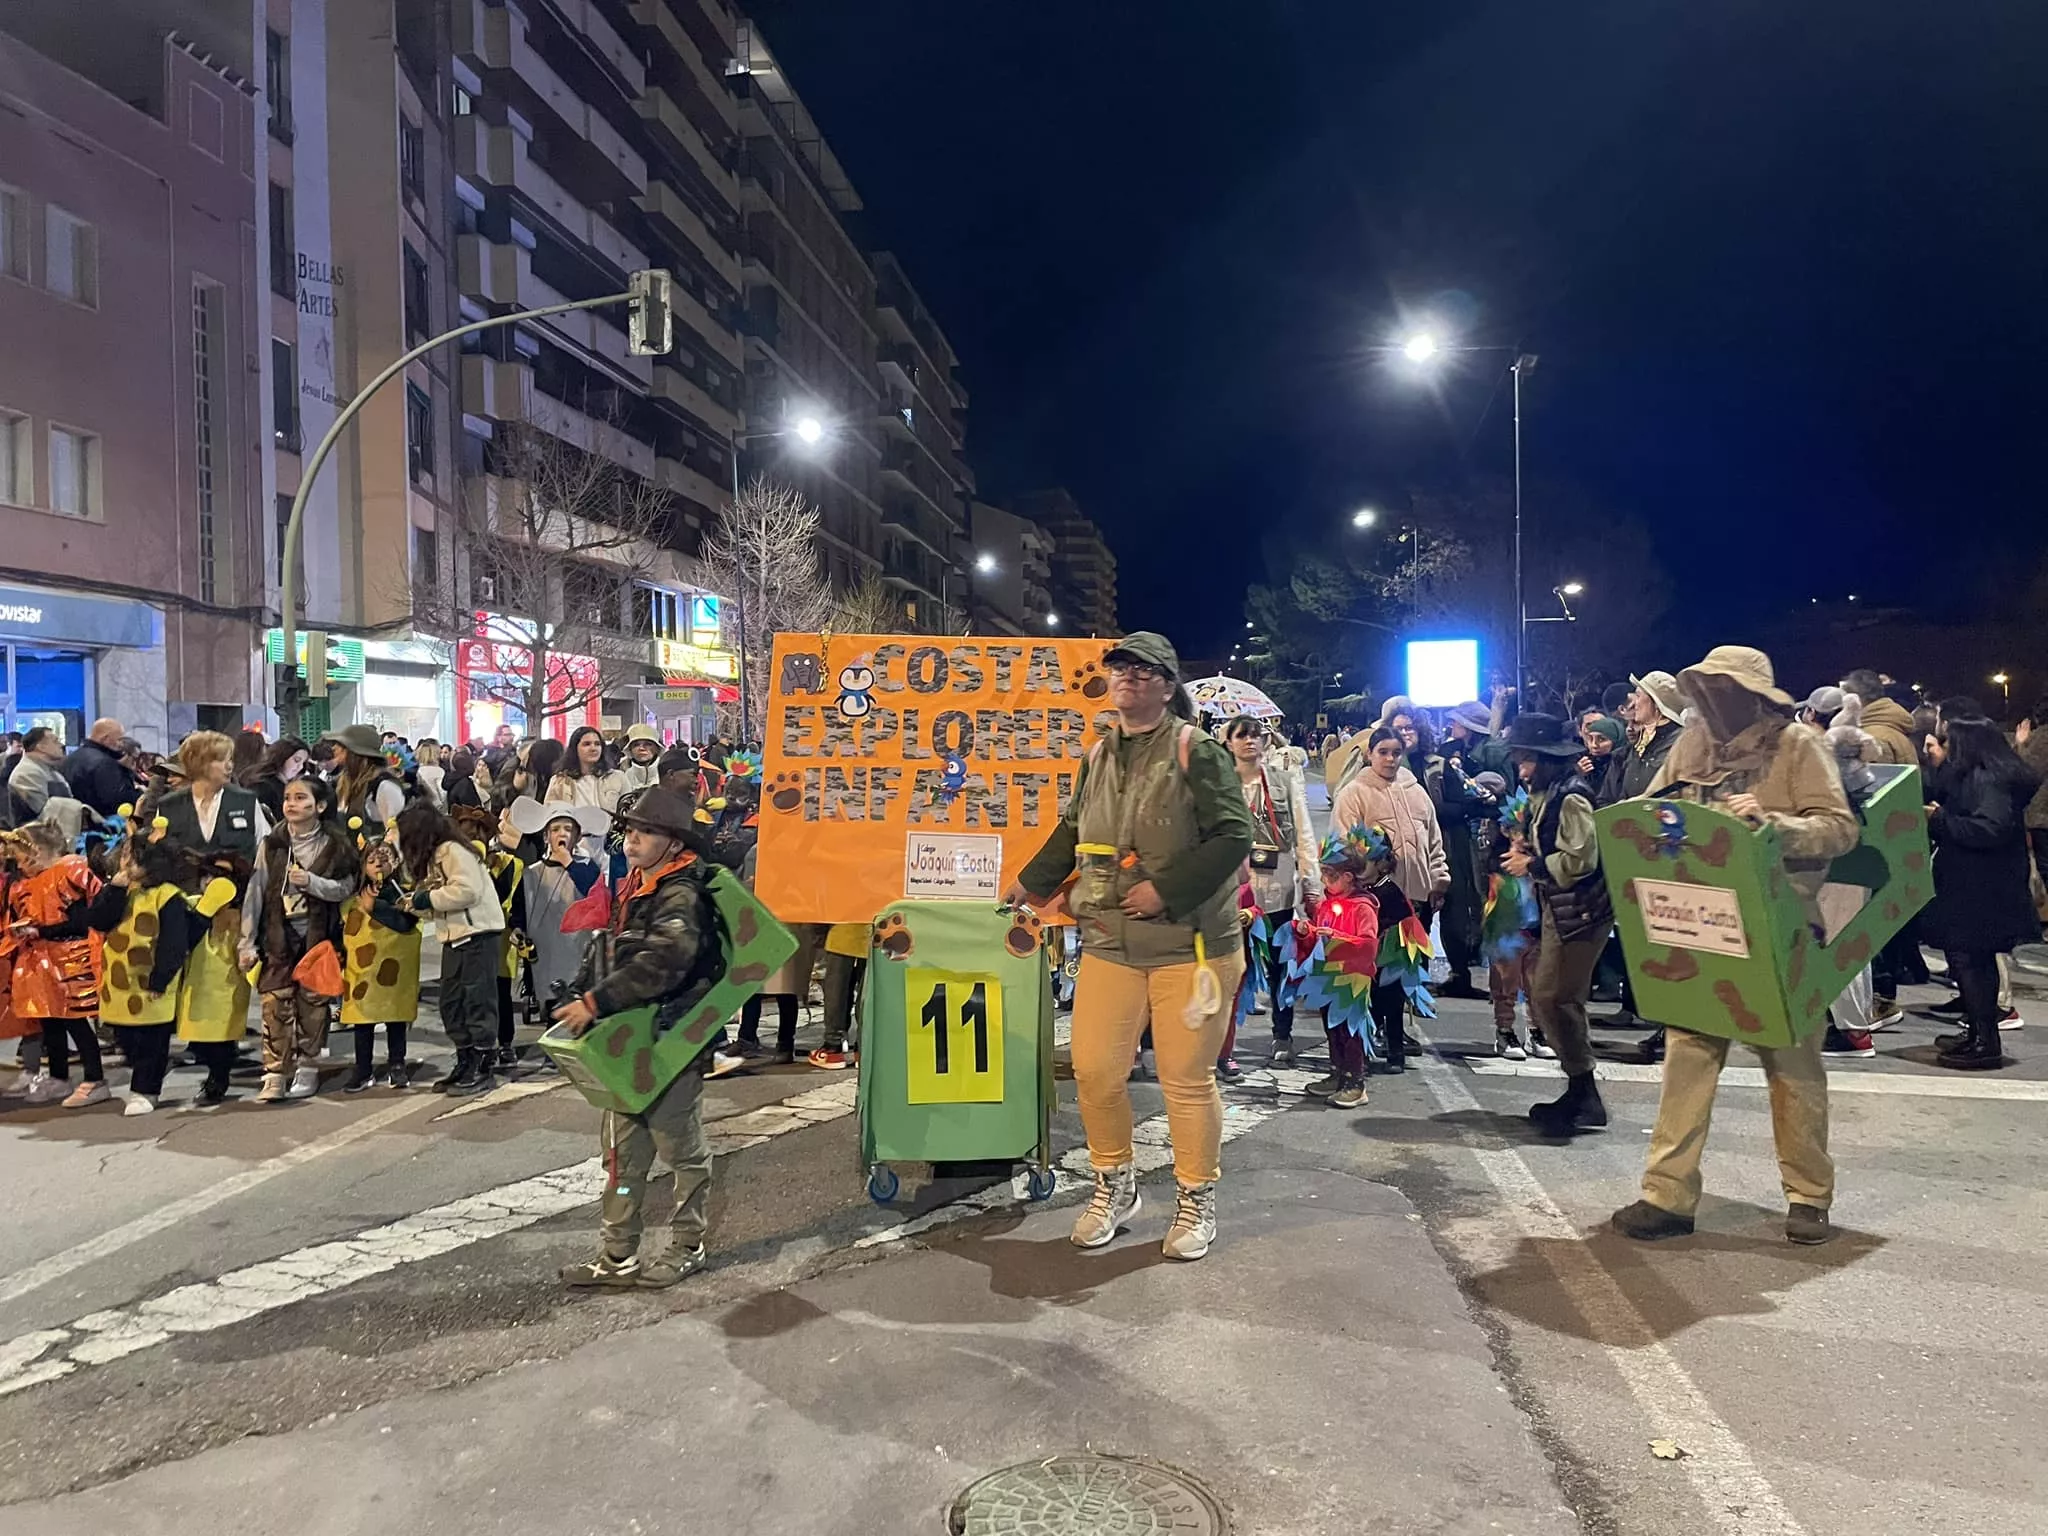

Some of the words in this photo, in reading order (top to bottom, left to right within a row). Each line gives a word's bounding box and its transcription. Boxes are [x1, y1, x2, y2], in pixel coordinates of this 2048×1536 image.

[872, 643, 1066, 695] COSTA
[665, 691, 689, 699] ONCE
[962, 853, 995, 873] Costa
[920, 982, 989, 1075] 11
